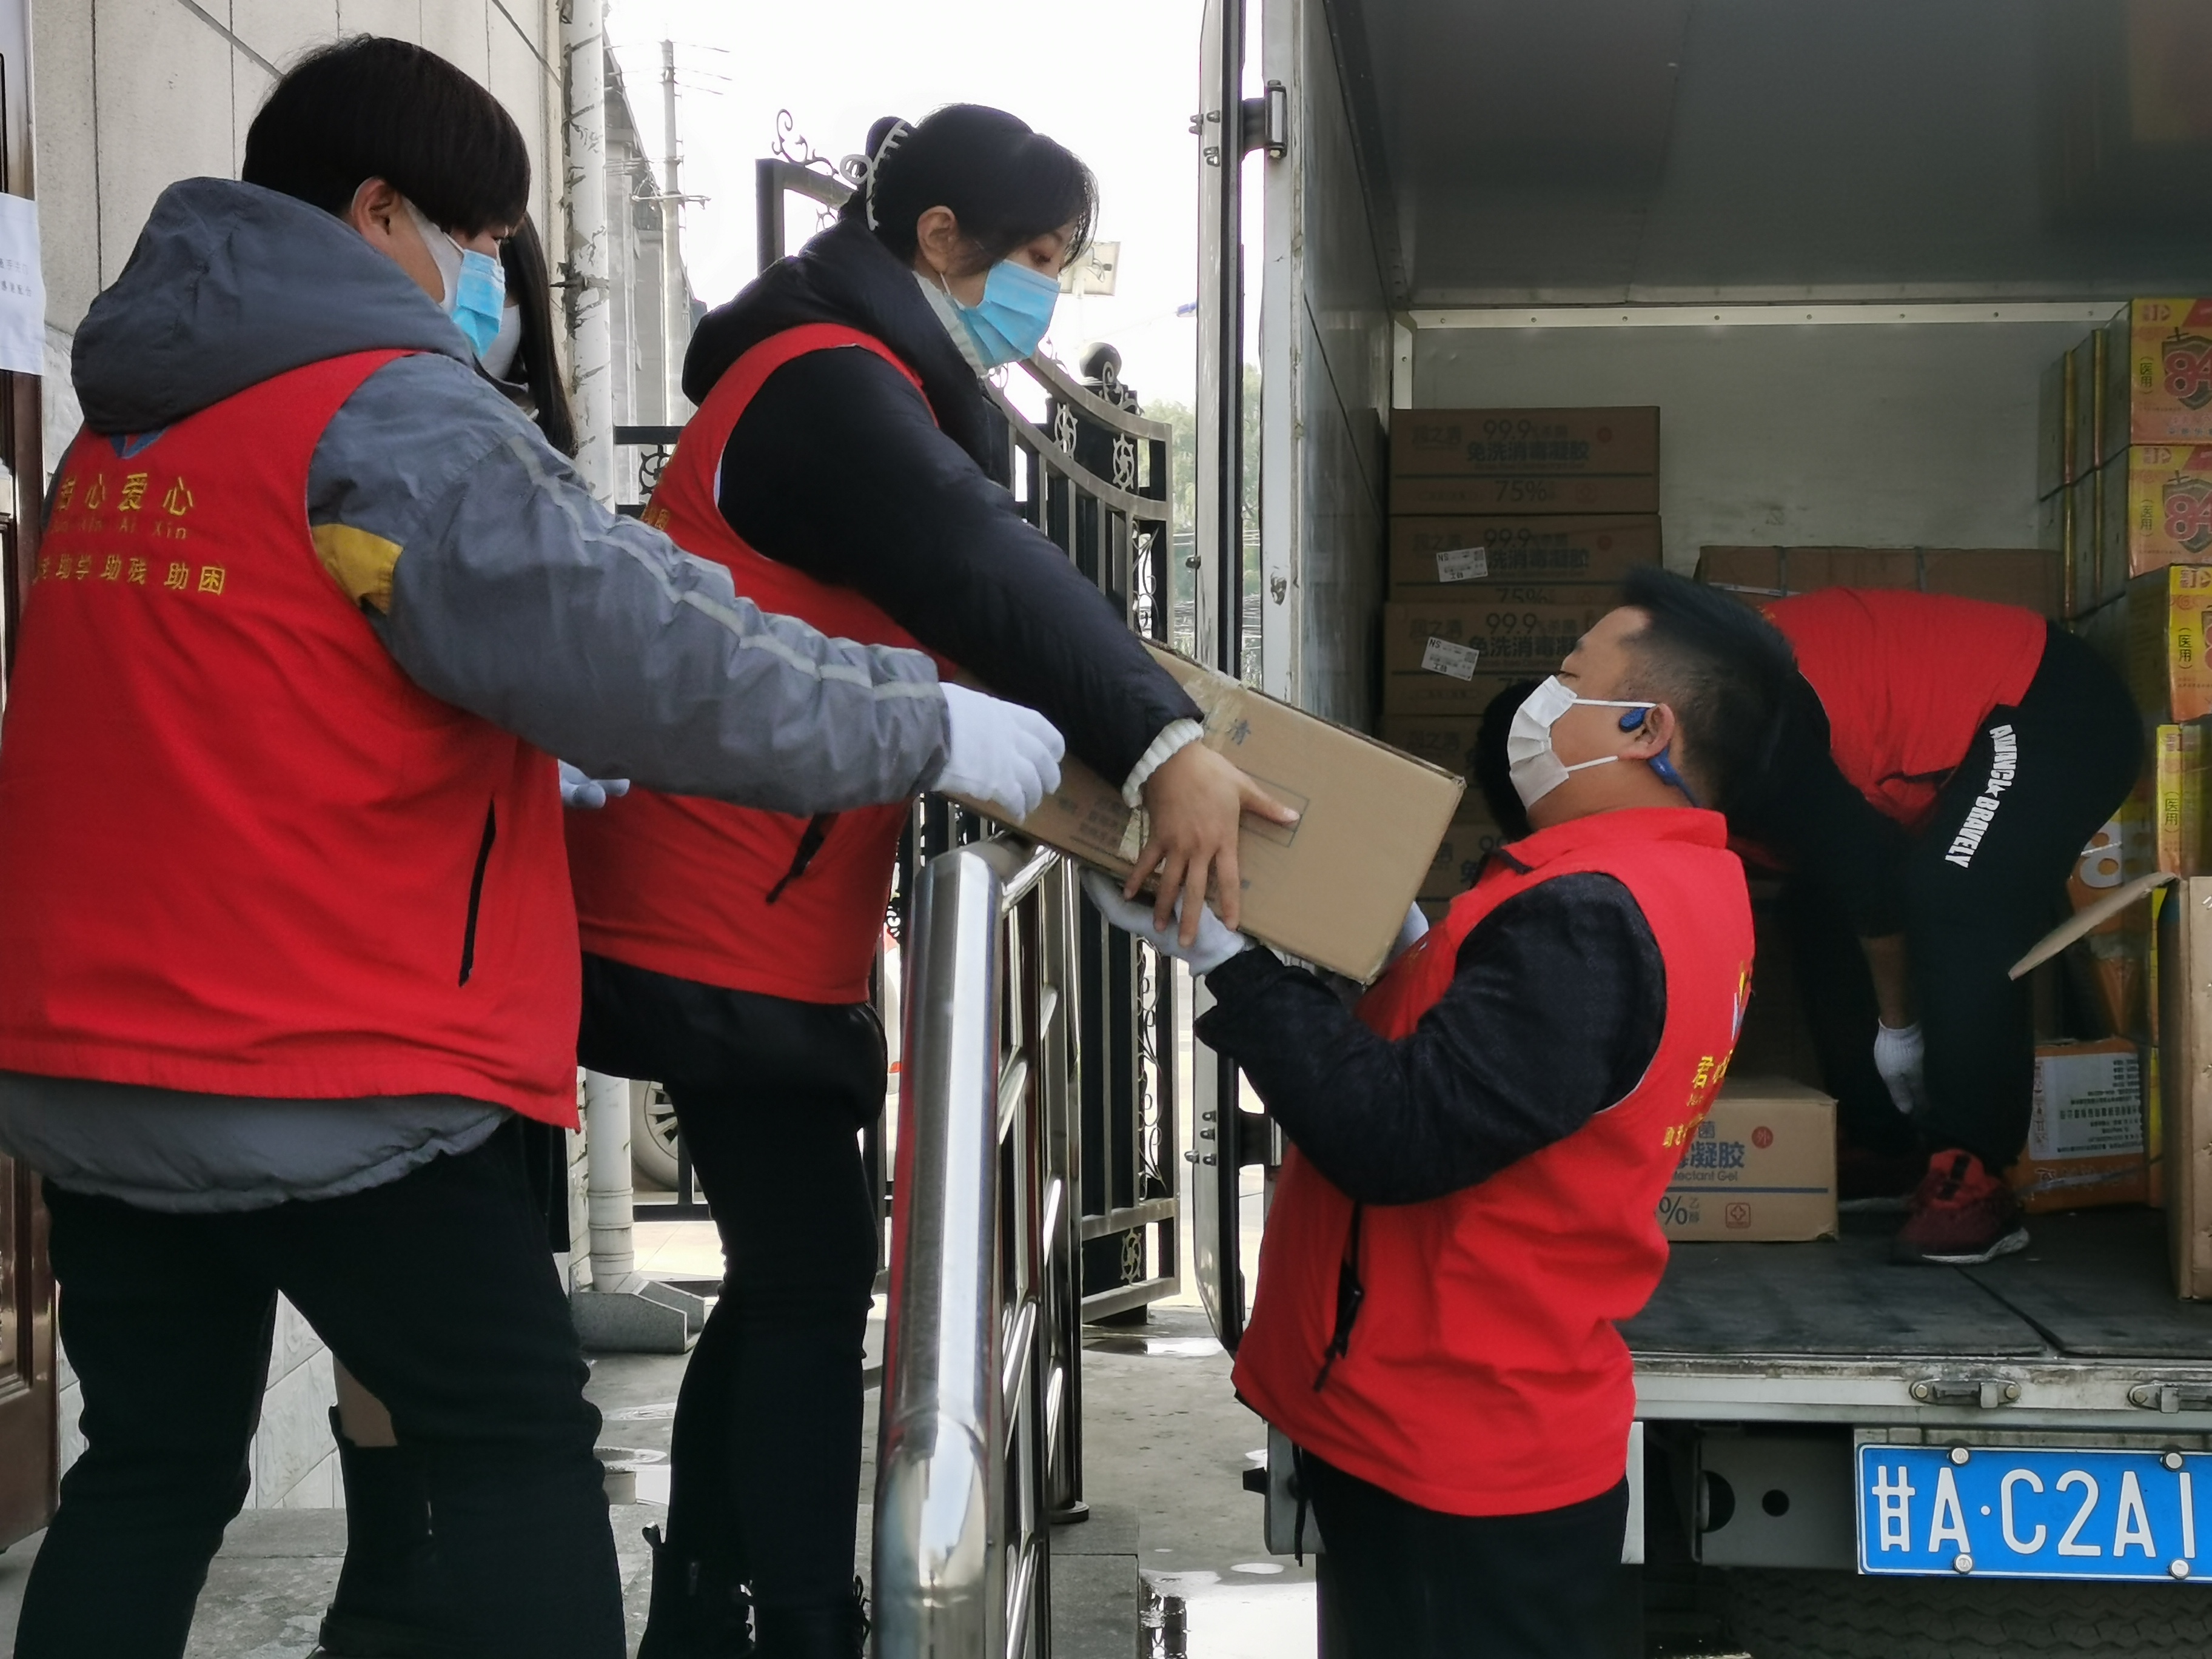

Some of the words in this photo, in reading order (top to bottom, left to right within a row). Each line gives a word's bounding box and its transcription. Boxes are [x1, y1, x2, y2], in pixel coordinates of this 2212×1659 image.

[1466, 440, 1590, 461] 免洗消毒凝胶
[1494, 479, 1547, 503] 75%
[153, 521, 186, 538] Xin
[1487, 548, 1590, 569] 洗消毒凝胶
[1945, 796, 2000, 868] BRAVELY
